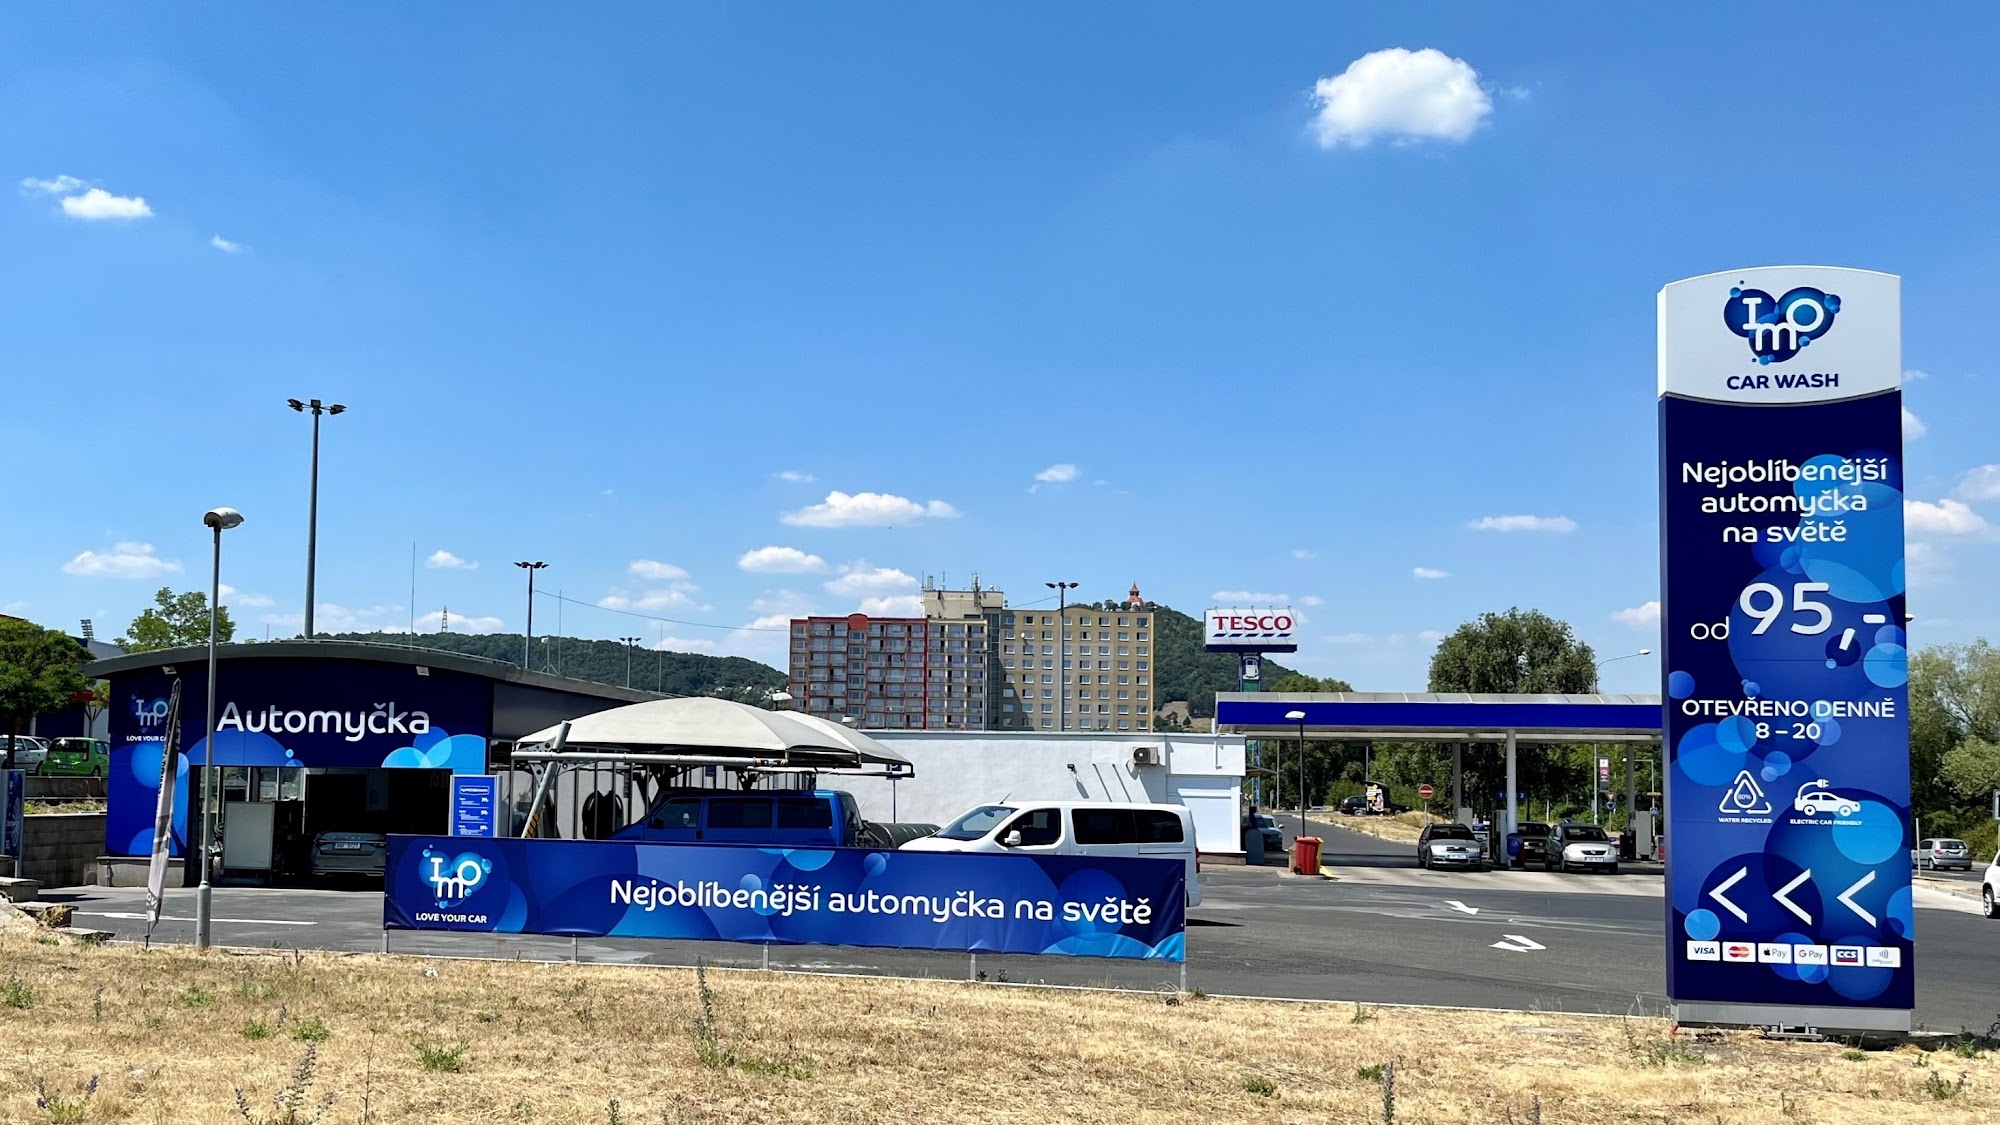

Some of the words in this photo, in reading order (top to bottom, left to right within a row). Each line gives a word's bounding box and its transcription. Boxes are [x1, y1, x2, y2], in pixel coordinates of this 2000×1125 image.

[1726, 375, 1770, 390] CAR
[1774, 373, 1839, 389] WASH
[1682, 458, 1888, 488] Nejoblíbenější
[1701, 488, 1867, 517] automyčka
[1722, 526, 1758, 544] na
[1766, 520, 1847, 543] světě
[1212, 616, 1292, 631] TESCO
[1690, 616, 1729, 640] od
[1682, 697, 1809, 717] OTEVŘENO
[1815, 697, 1895, 718] DENNĚ
[216, 702, 430, 742] Automyčka
[1755, 722, 1770, 739] 8
[1792, 722, 1821, 740] 20
[610, 879, 821, 917] Nejoblíbenější
[828, 890, 1005, 923] automyčka
[1015, 900, 1053, 921] na
[1063, 896, 1152, 925] světě
[415, 912, 440, 922] LOVE
[441, 913, 467, 923] YOUR
[468, 914, 488, 924] CAR
[1694, 947, 1715, 955] VISA
[1772, 948, 1787, 959] Pay
[1808, 950, 1823, 959] Pay
[1836, 950, 1857, 959] CCS
